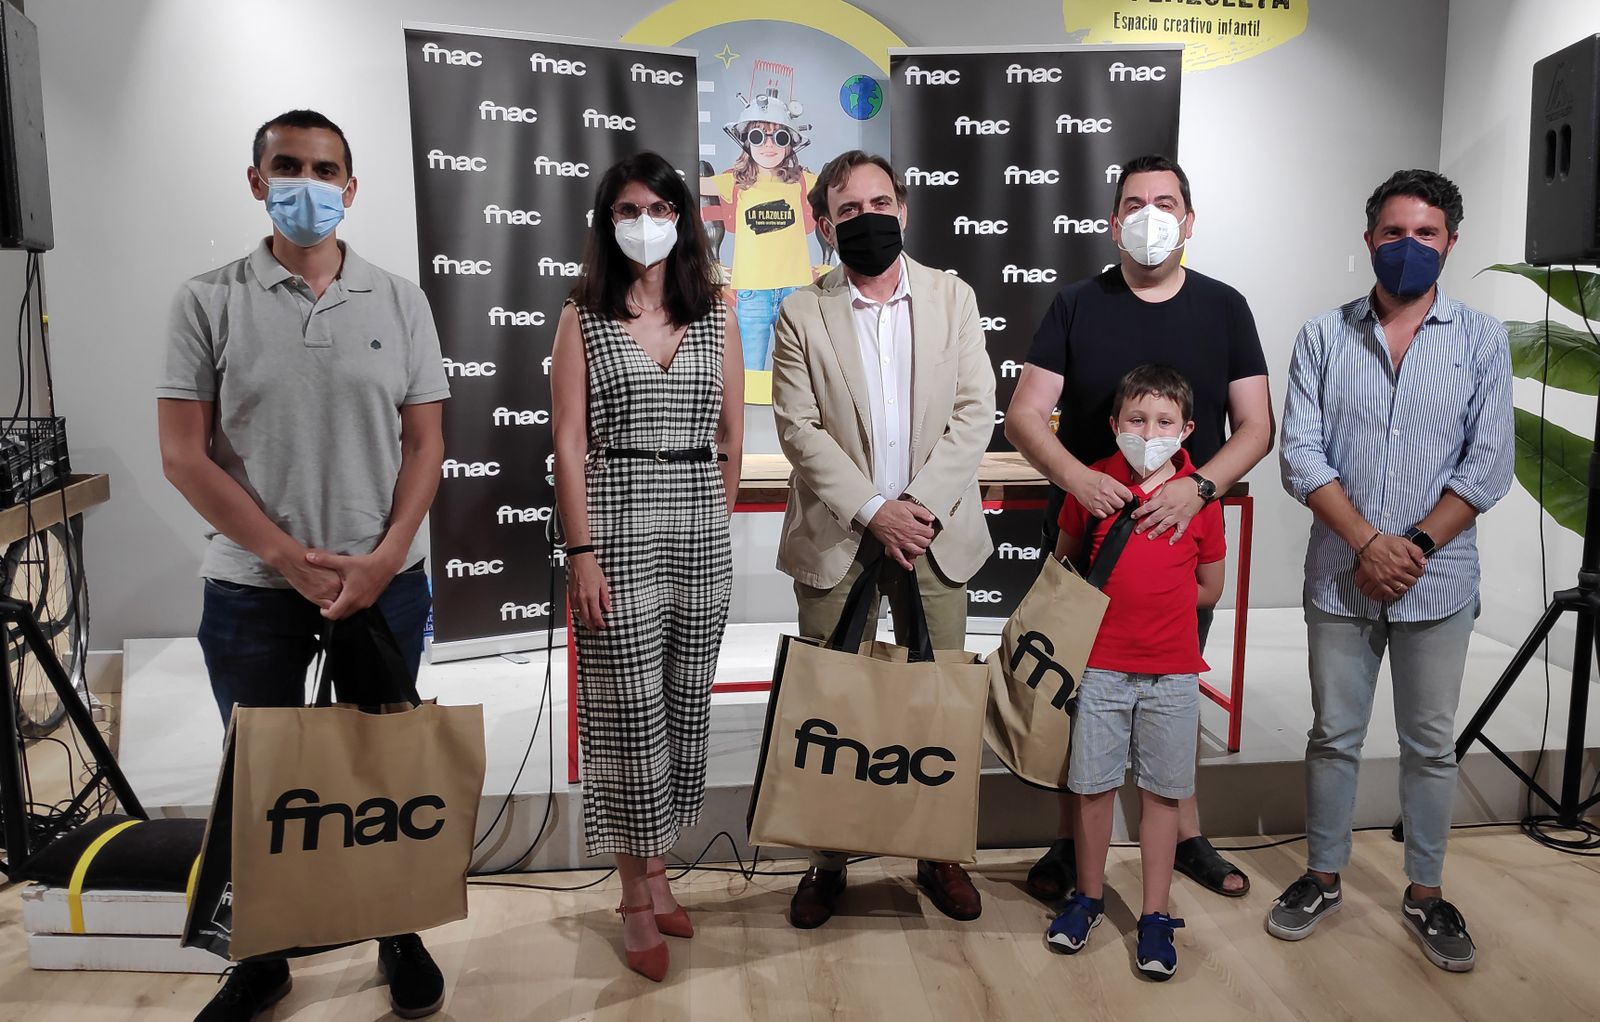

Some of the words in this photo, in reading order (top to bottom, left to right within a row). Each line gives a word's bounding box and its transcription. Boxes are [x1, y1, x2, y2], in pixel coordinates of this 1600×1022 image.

[1113, 12, 1158, 31] Espacio
[1164, 17, 1212, 34] creativo
[1218, 18, 1260, 37] infantil
[422, 43, 483, 67] fnac
[530, 53, 587, 76] fnac
[630, 63, 684, 86] fnac
[905, 66, 960, 85] fnac
[1006, 64, 1062, 83] fnac
[1109, 62, 1166, 82] fnac
[479, 100, 538, 123] fnac
[583, 109, 636, 131] fnac
[955, 116, 1010, 135] fnac
[1056, 114, 1112, 134] fnac
[427, 149, 487, 172] fnac
[534, 156, 590, 178] fnac
[905, 167, 959, 186] fnac
[1004, 165, 1060, 184] fnac
[483, 204, 541, 225] fnac
[748, 210, 756, 219] LA
[759, 210, 792, 219] PLAZOLETA
[1053, 215, 1108, 234] fnac
[954, 216, 1008, 235] fnac
[433, 254, 491, 275] fnac
[1002, 264, 1057, 283] fnac
[488, 307, 545, 326] fnac
[493, 407, 549, 426] fnac
[442, 459, 500, 478] fnac
[497, 506, 552, 524] fnac
[446, 558, 503, 578] fnac
[1010, 631, 1078, 717] fn
[794, 718, 956, 786] fnac
[266, 788, 446, 854] fnac
